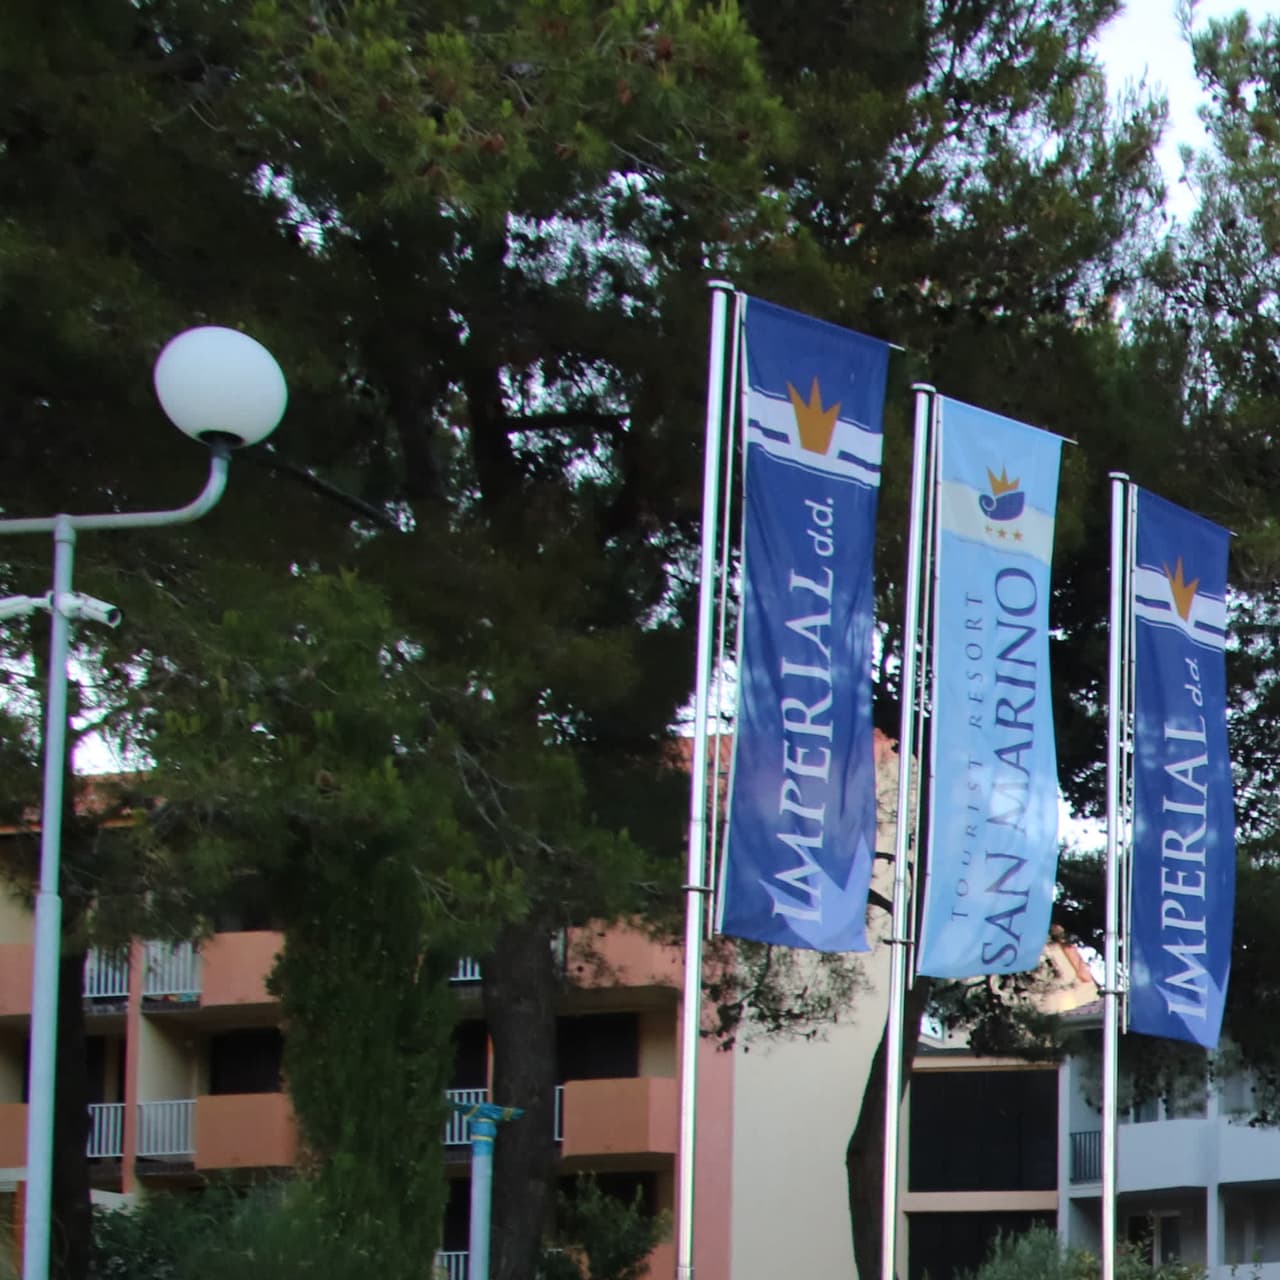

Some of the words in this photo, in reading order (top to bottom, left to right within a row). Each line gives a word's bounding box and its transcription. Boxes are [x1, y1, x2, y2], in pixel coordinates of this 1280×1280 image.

[771, 567, 834, 924] IMPERIAL
[804, 497, 834, 557] d.d.
[965, 592, 983, 729] RESORT
[986, 567, 1038, 836] MARINO
[951, 753, 983, 922] TOURIST
[981, 849, 1030, 967] SAN
[1161, 715, 1208, 1021] IMPERIAL
